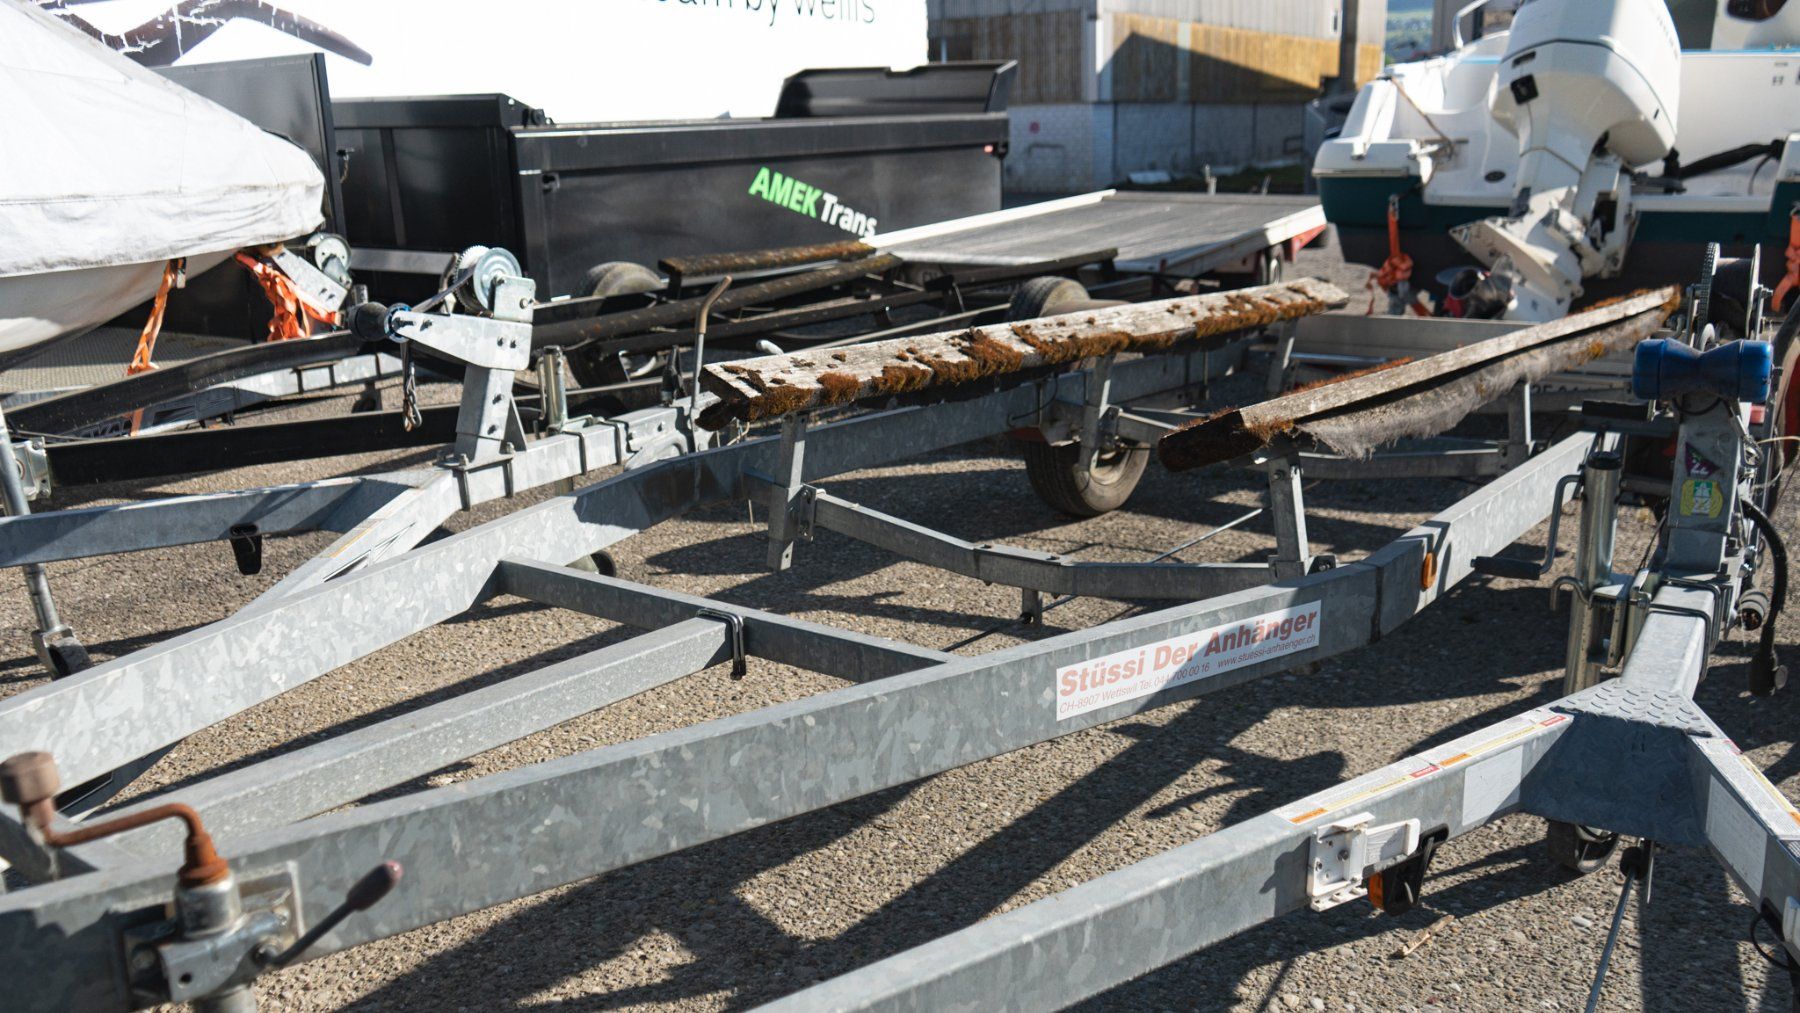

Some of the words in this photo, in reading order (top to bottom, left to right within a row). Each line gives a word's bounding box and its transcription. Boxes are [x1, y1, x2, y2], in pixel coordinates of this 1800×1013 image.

[745, 0, 778, 27] y
[1060, 650, 1146, 697] Stüssi
[1153, 641, 1199, 672] Der
[1203, 611, 1318, 658] Anhänger
[1172, 668, 1188, 681] 700
[1188, 664, 1200, 678] 00
[1201, 662, 1211, 674] 16
[1217, 633, 1317, 670] www.stuessi-anhaenger.ch
